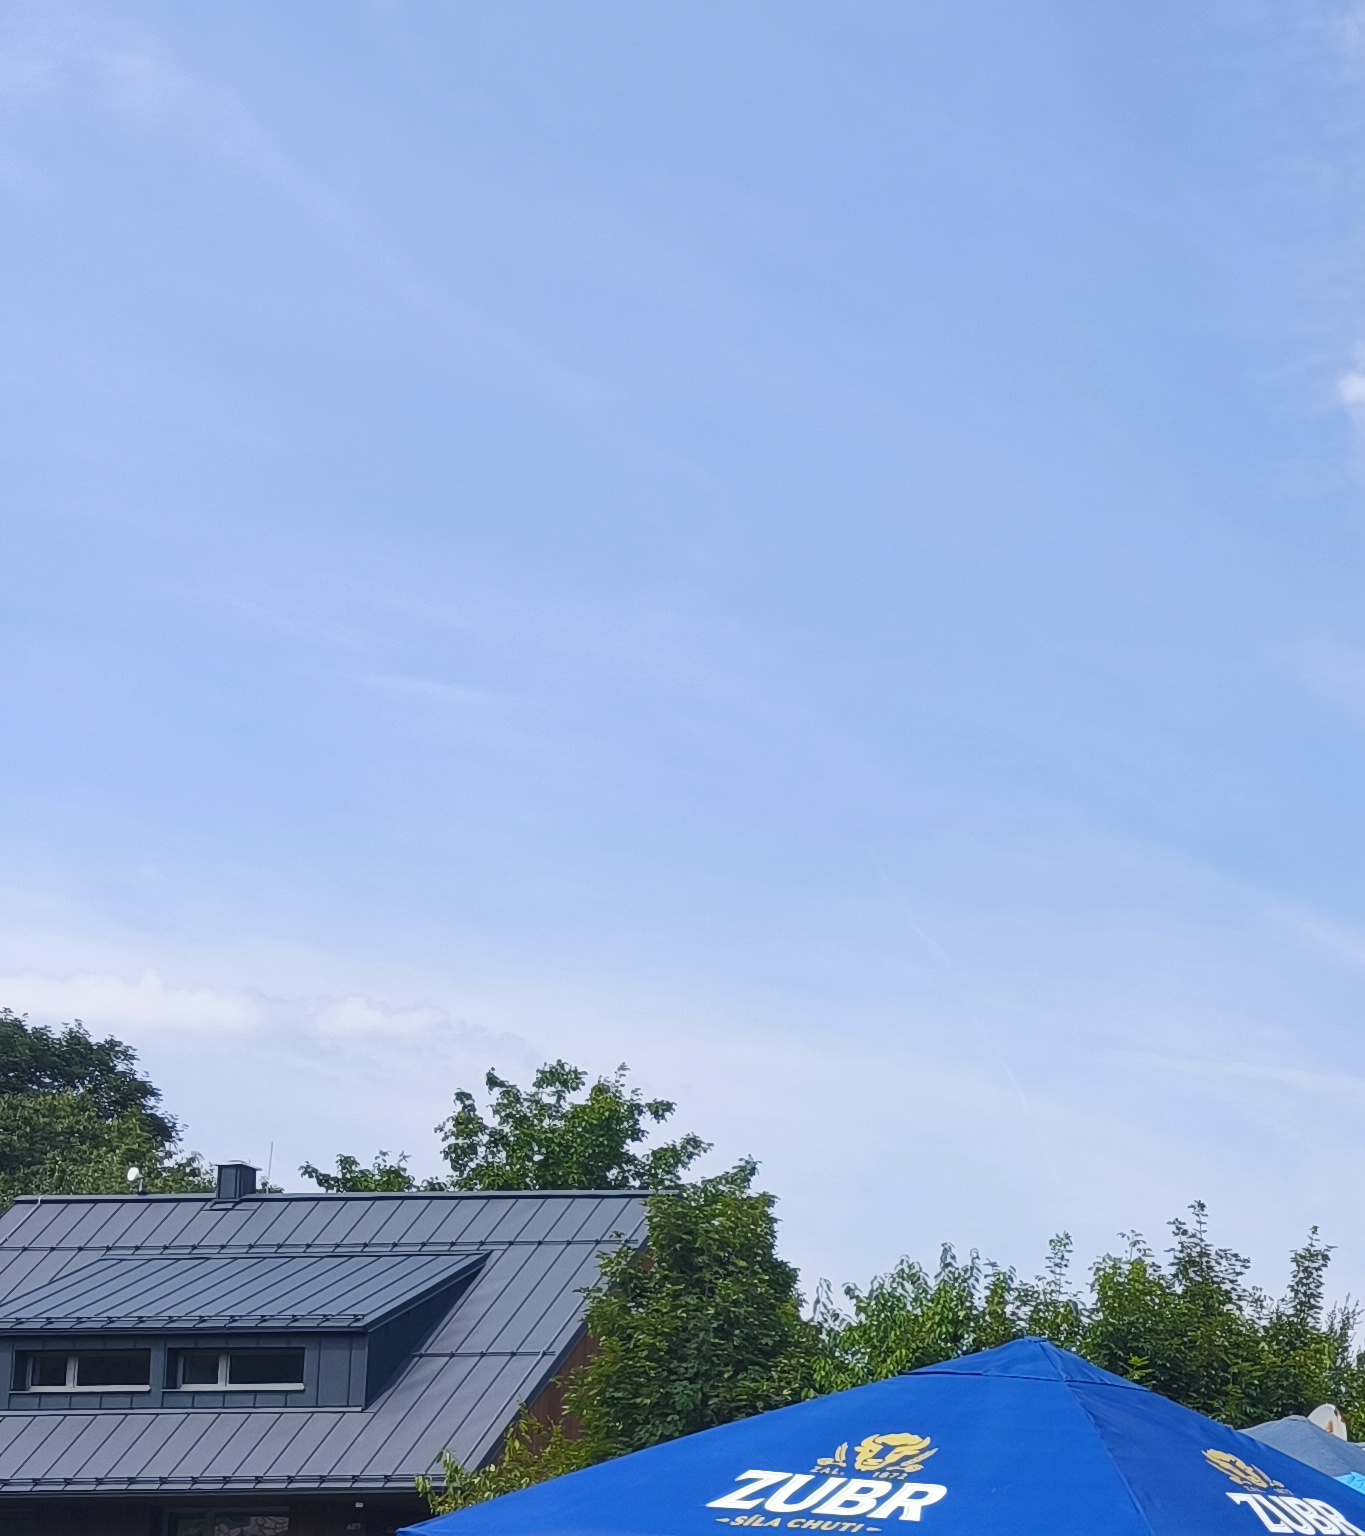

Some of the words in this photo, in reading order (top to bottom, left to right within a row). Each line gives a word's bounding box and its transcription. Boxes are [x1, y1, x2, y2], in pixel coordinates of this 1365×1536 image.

[705, 1469, 948, 1522] ZUBR
[729, 1513, 782, 1528] SÍLA
[787, 1518, 865, 1533] CHUTI
